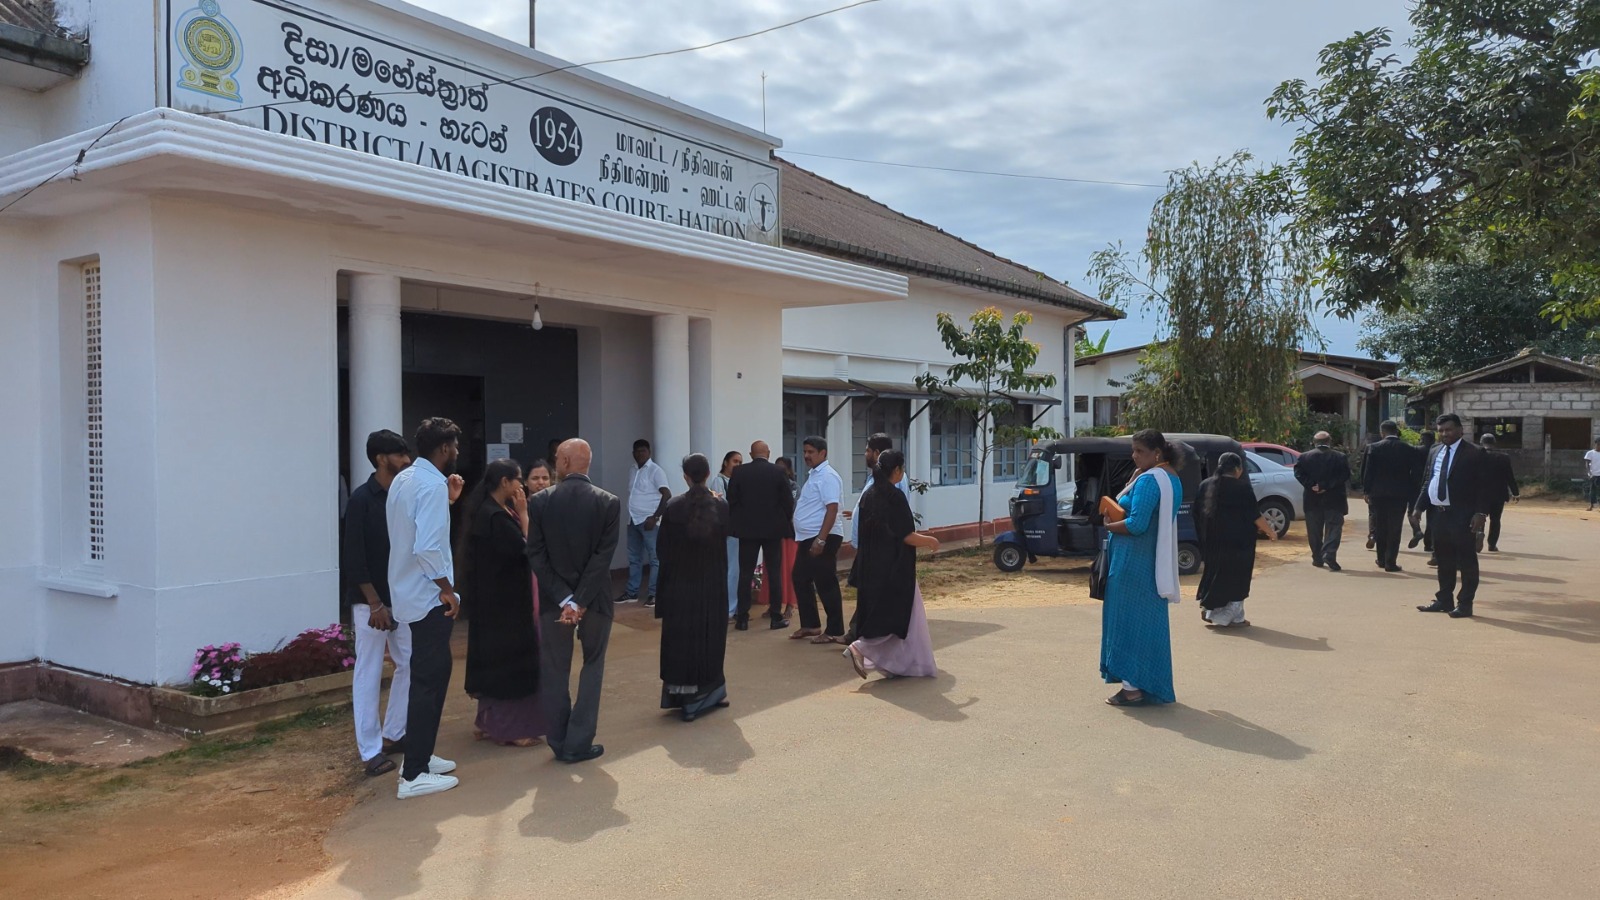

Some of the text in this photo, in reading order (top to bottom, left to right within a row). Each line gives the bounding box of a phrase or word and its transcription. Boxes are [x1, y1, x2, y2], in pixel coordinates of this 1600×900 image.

[257, 65, 407, 127] අධිකරණය
[440, 116, 508, 153] හැටන්
[533, 113, 580, 157] 1954
[599, 154, 670, 194] நீதிமன்றம்
[701, 185, 746, 213] ஹட்டன்
[678, 208, 746, 240] HATTON
